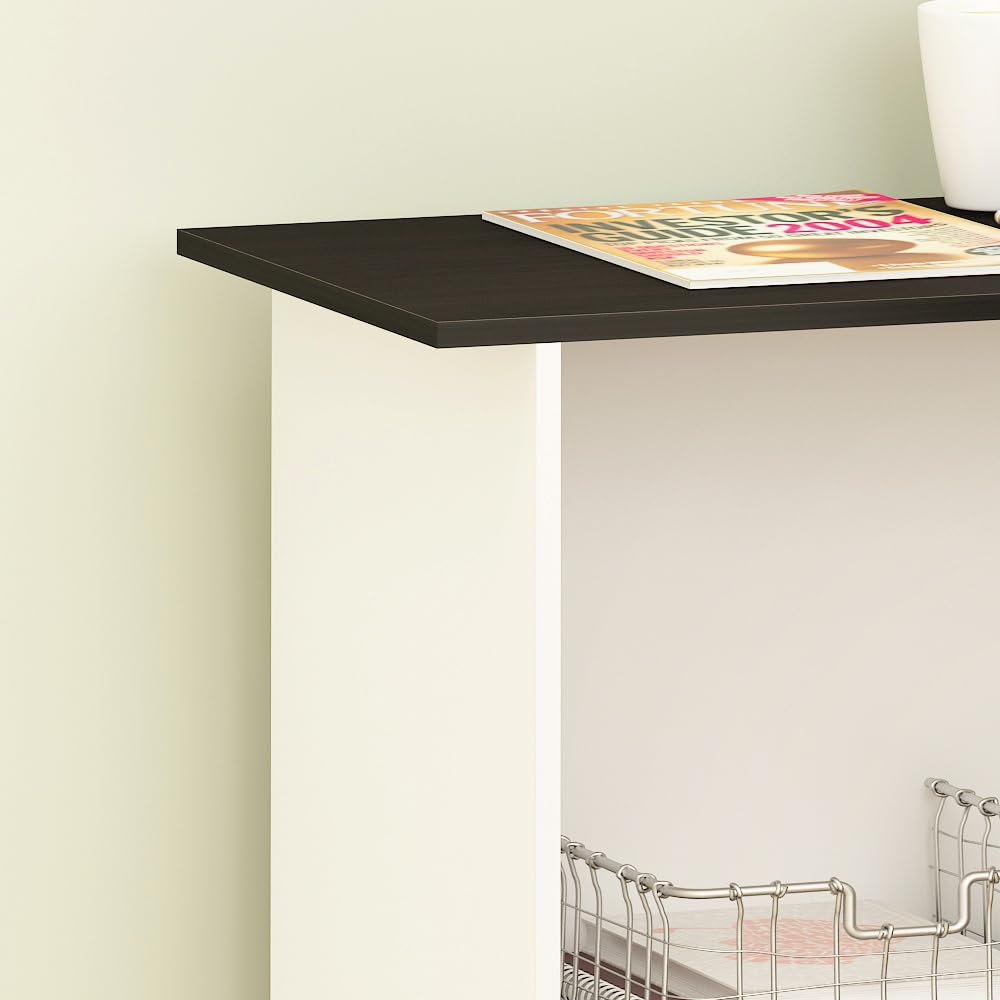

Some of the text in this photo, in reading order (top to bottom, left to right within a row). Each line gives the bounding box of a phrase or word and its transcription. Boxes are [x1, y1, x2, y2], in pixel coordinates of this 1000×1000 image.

[548, 205, 905, 234] INVESTOR'S
[578, 213, 932, 243] GUIDE 2004
